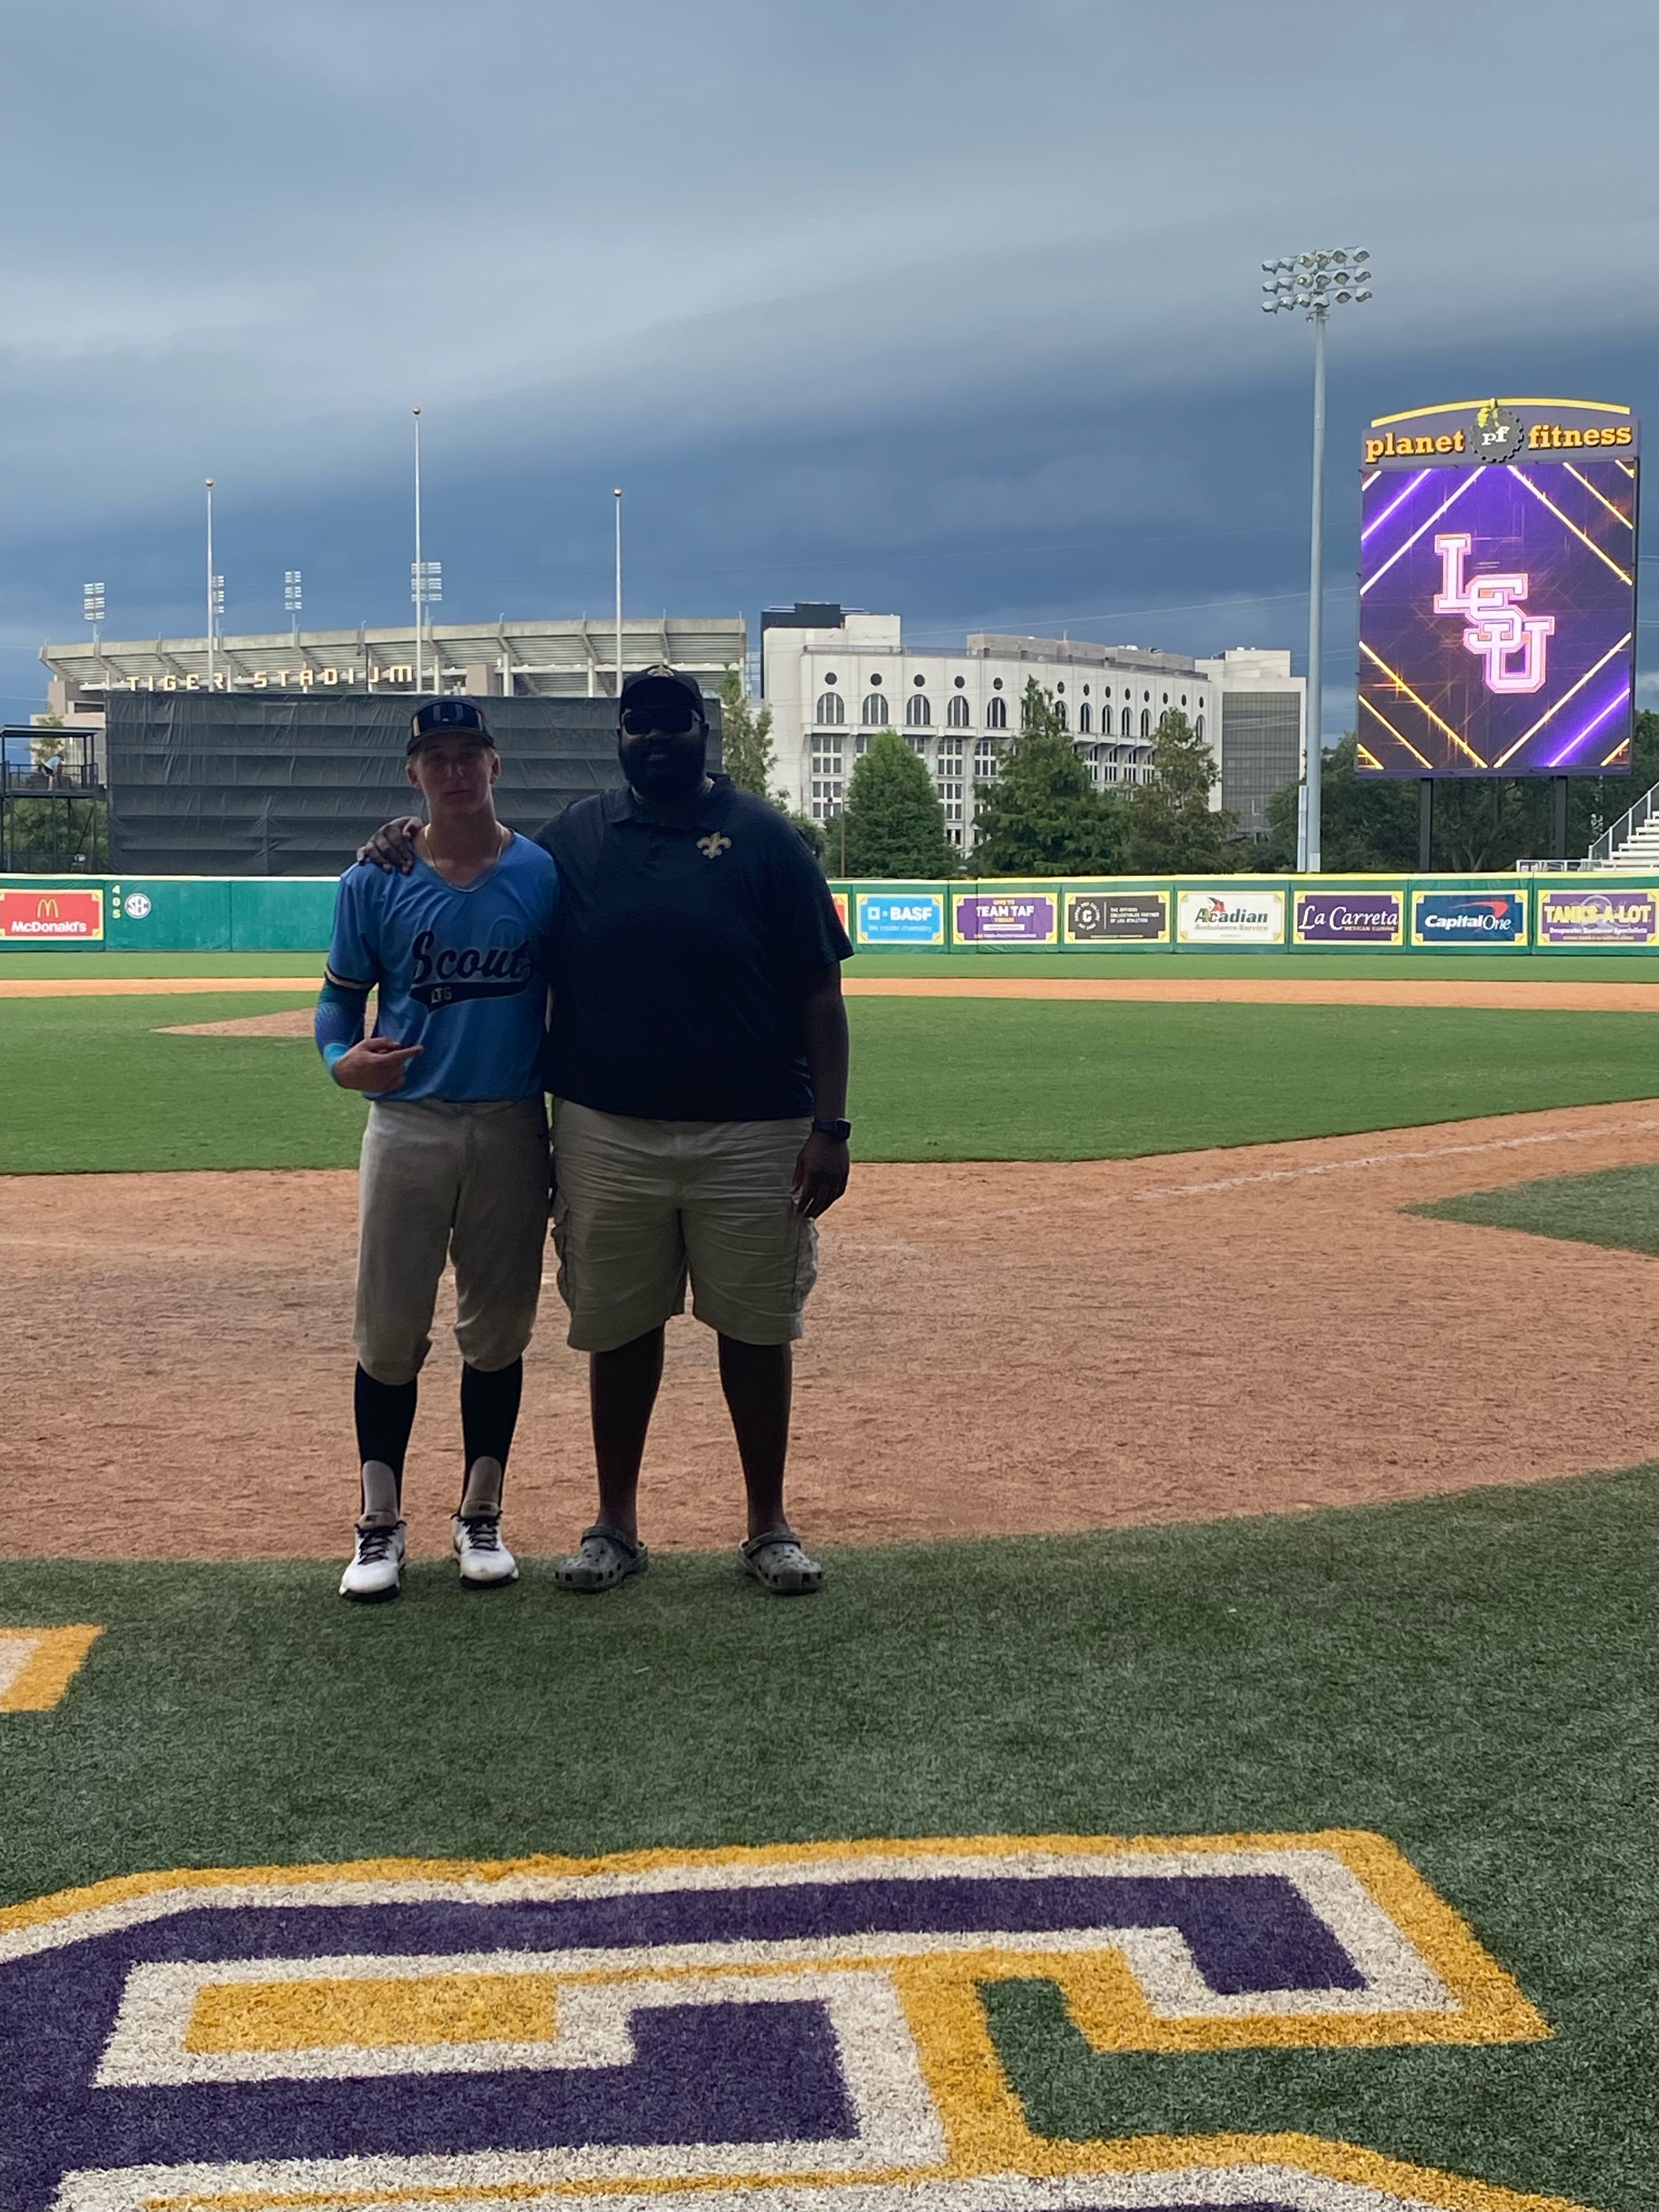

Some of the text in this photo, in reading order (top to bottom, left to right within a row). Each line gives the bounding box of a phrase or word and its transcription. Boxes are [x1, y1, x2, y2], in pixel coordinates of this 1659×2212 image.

[1365, 425, 1633, 463] planet fitness
[1482, 426, 1510, 445] pf
[1434, 533, 1556, 694] LSU
[126, 665, 413, 692] TIGER STADIUM
[890, 906, 933, 921] BASF
[976, 906, 1034, 917] TEAM TAF
[1195, 908, 1268, 923] Acadian
[1298, 905, 1399, 930] La Carreta
[11, 921, 87, 933] McDonald's
[413, 930, 531, 984] Scout
